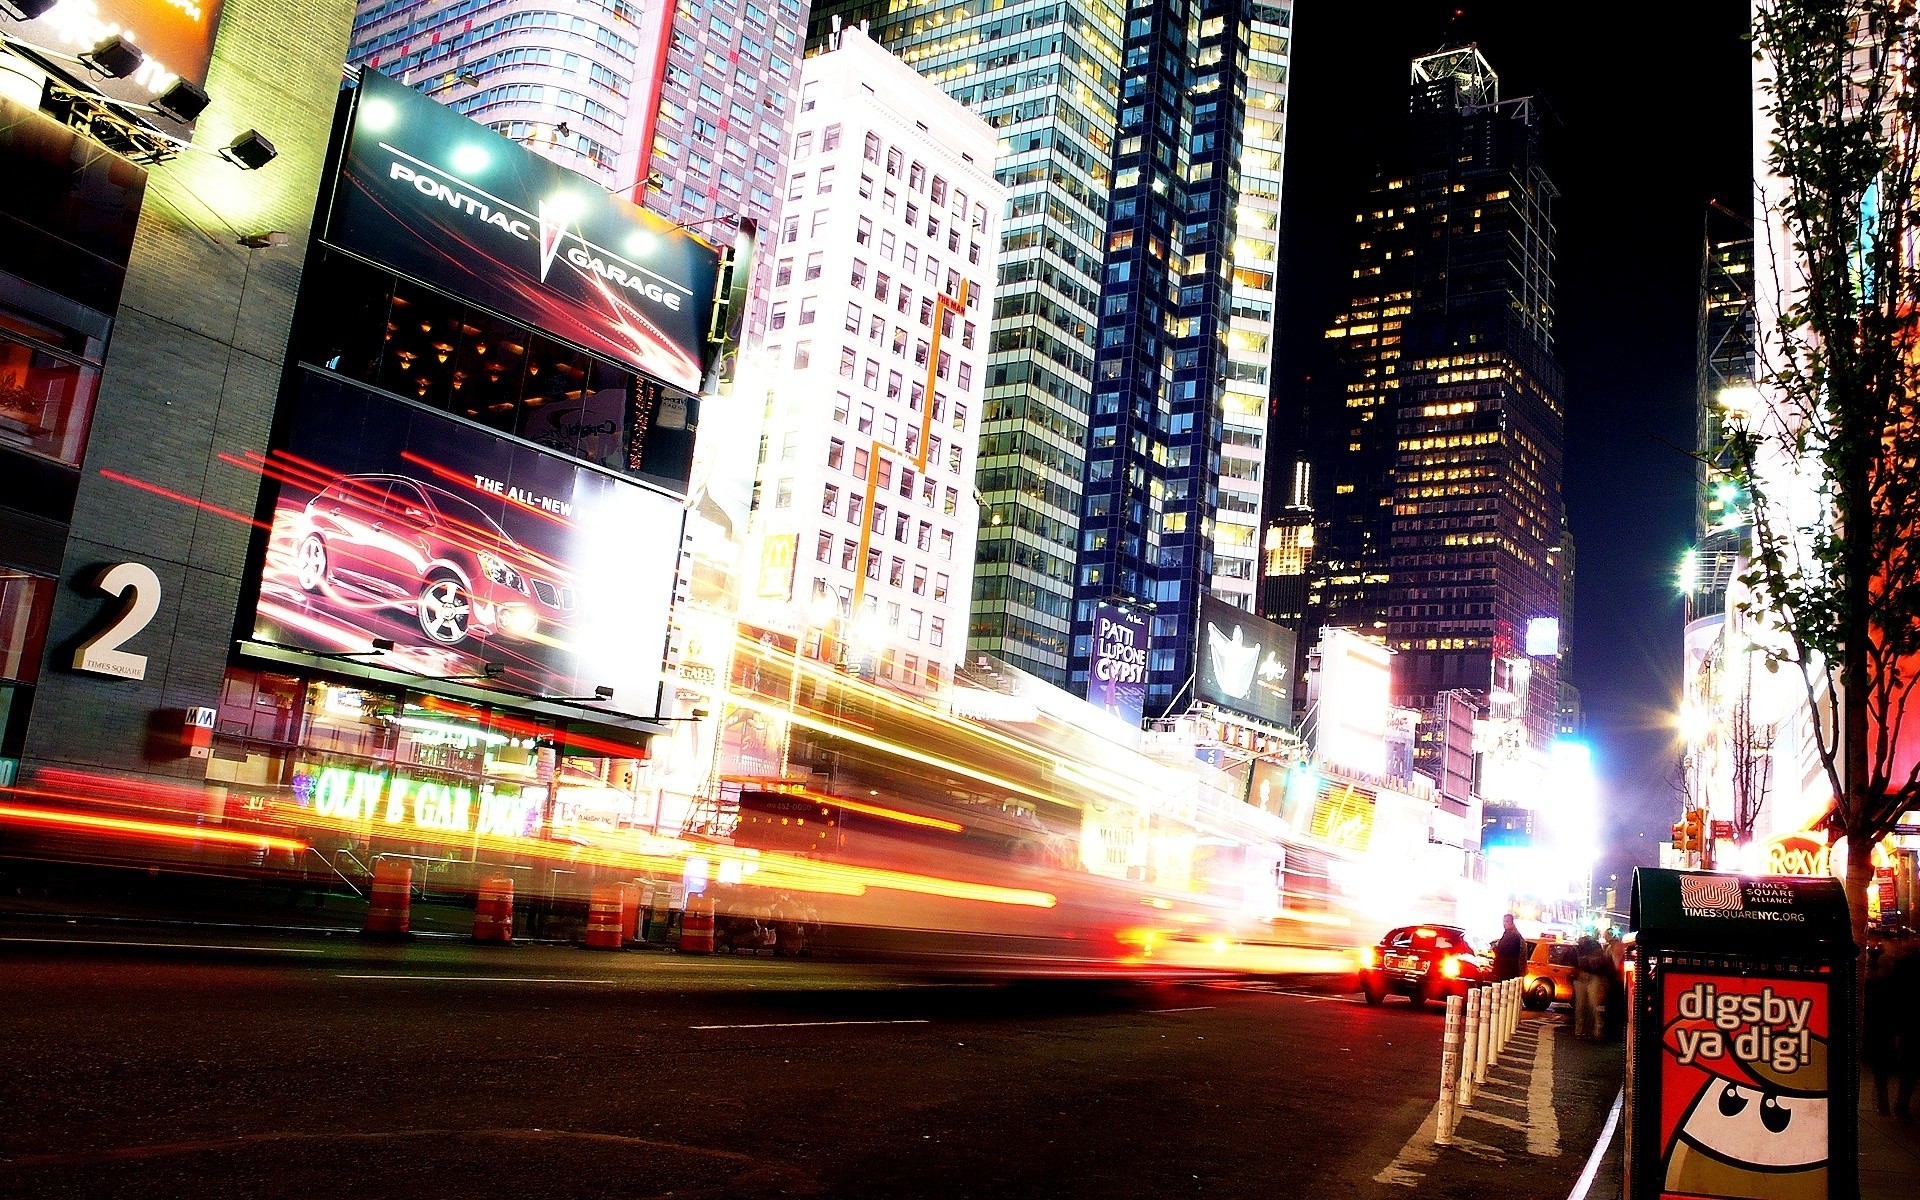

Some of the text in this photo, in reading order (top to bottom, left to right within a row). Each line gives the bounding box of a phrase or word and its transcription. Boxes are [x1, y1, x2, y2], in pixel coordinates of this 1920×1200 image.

[390, 162, 681, 311] PONTIAC GARAGE
[474, 474, 504, 496] THE
[507, 486, 574, 517] ALL-NEW
[78, 562, 162, 681] 2
[1099, 617, 1135, 646] PATTI
[1098, 637, 1147, 666] LUPONE
[87, 659, 142, 677] TIMES SQUARE
[1095, 657, 1145, 684] GYPSY
[315, 767, 409, 824] OLIVE
[1746, 888, 1795, 898] SQUARE
[1749, 881, 1789, 890] TIMES
[1682, 907, 1806, 923] TIMESSQUARENYC.ORG
[1750, 897, 1794, 905] ALLIANCE
[1679, 984, 1812, 1032] digsby
[1677, 1026, 1811, 1073] ya dig!
